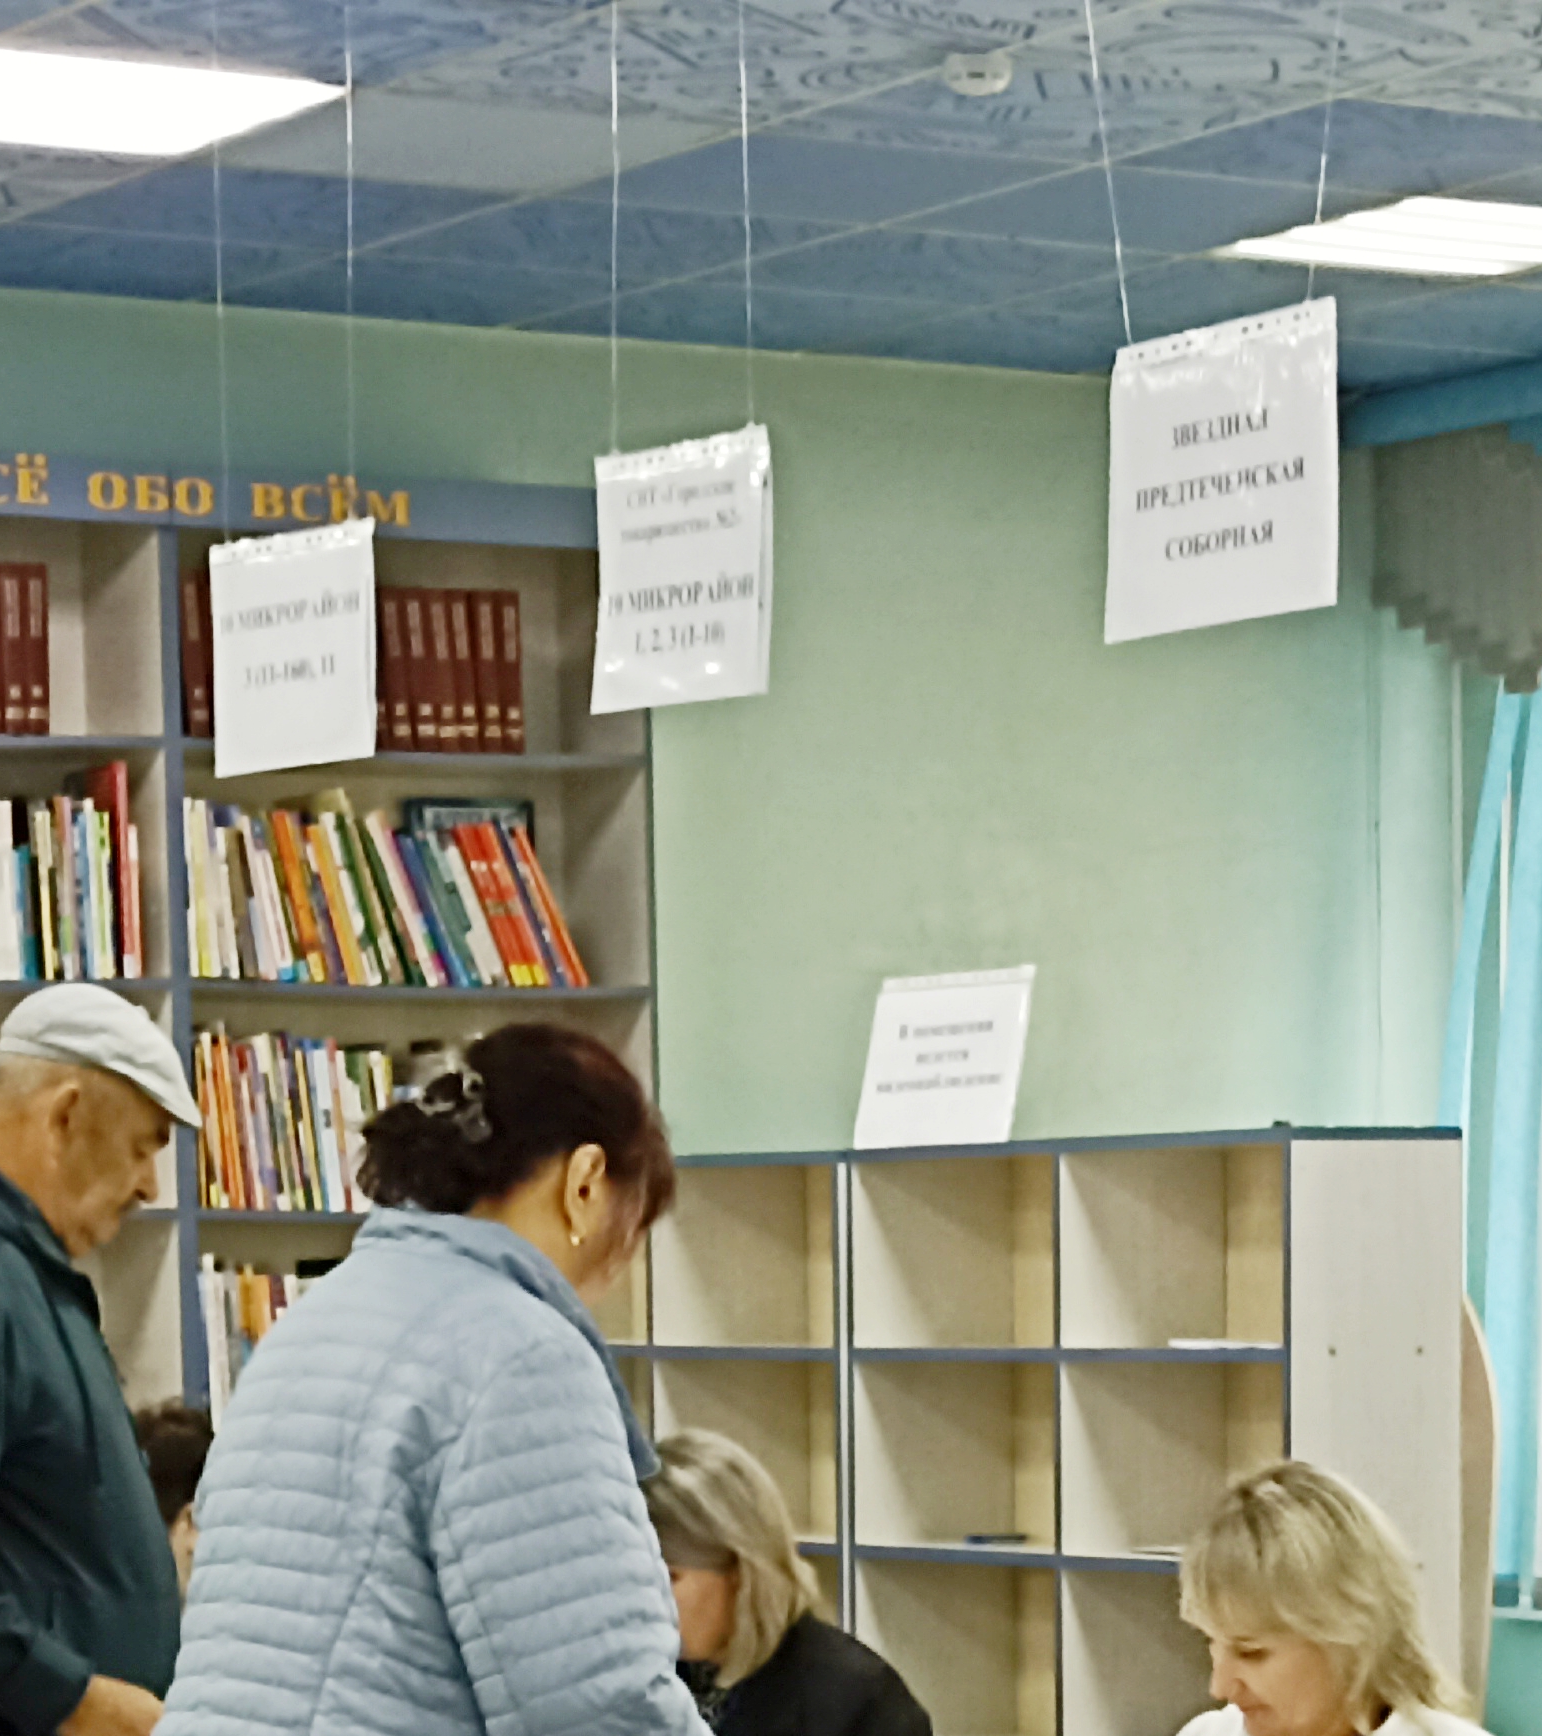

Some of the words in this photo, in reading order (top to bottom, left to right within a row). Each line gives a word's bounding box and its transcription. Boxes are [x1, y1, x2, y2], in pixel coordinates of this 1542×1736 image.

[1172, 407, 1269, 450] ЗВЕЗДНАЯ
[87, 472, 214, 517] ОБО
[251, 474, 410, 527] ВСЁМ
[1135, 455, 1305, 513] ПРЕДТЕЧЕНСКАЯ
[1164, 518, 1275, 562] СОБОРНАЯ
[627, 571, 755, 612] МИКРОРАЙОН
